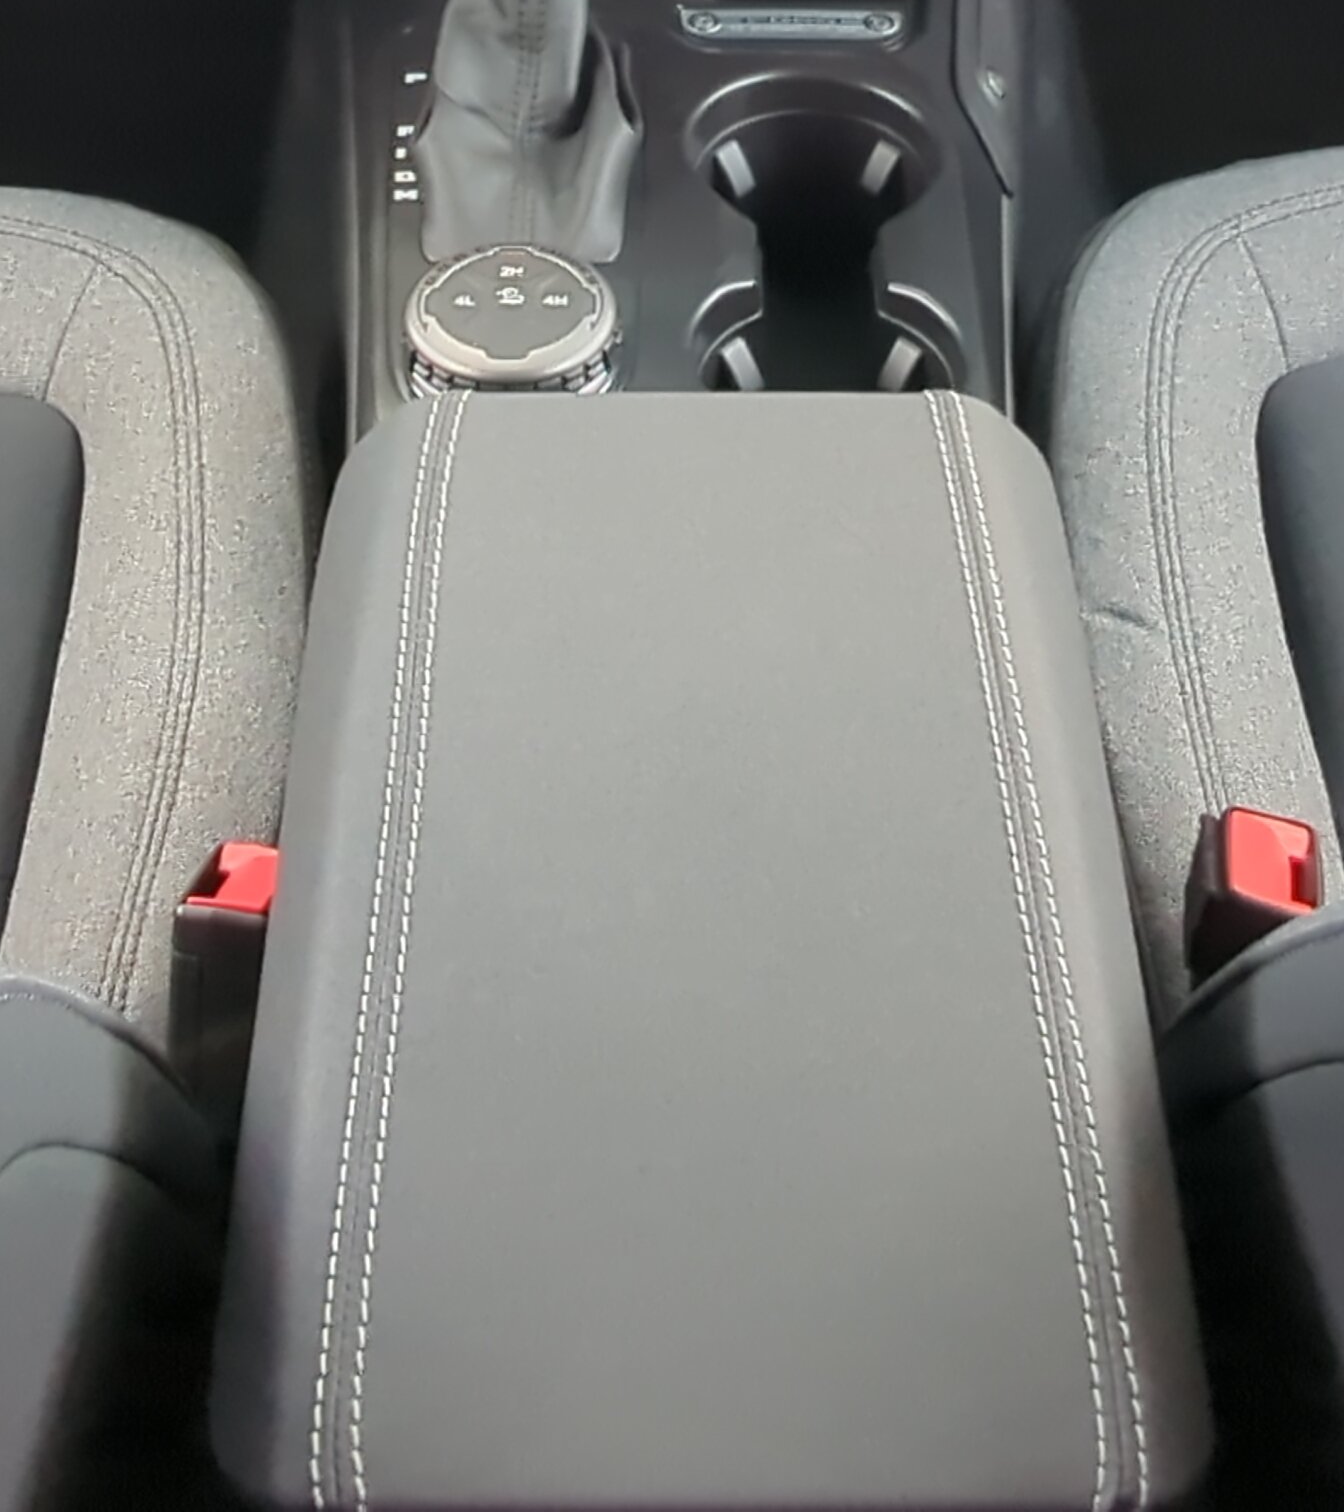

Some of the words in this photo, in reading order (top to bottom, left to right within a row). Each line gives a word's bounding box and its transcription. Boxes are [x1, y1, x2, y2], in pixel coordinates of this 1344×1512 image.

[499, 265, 525, 278] 2H
[454, 294, 476, 307] 4L
[542, 294, 569, 307] 4H
